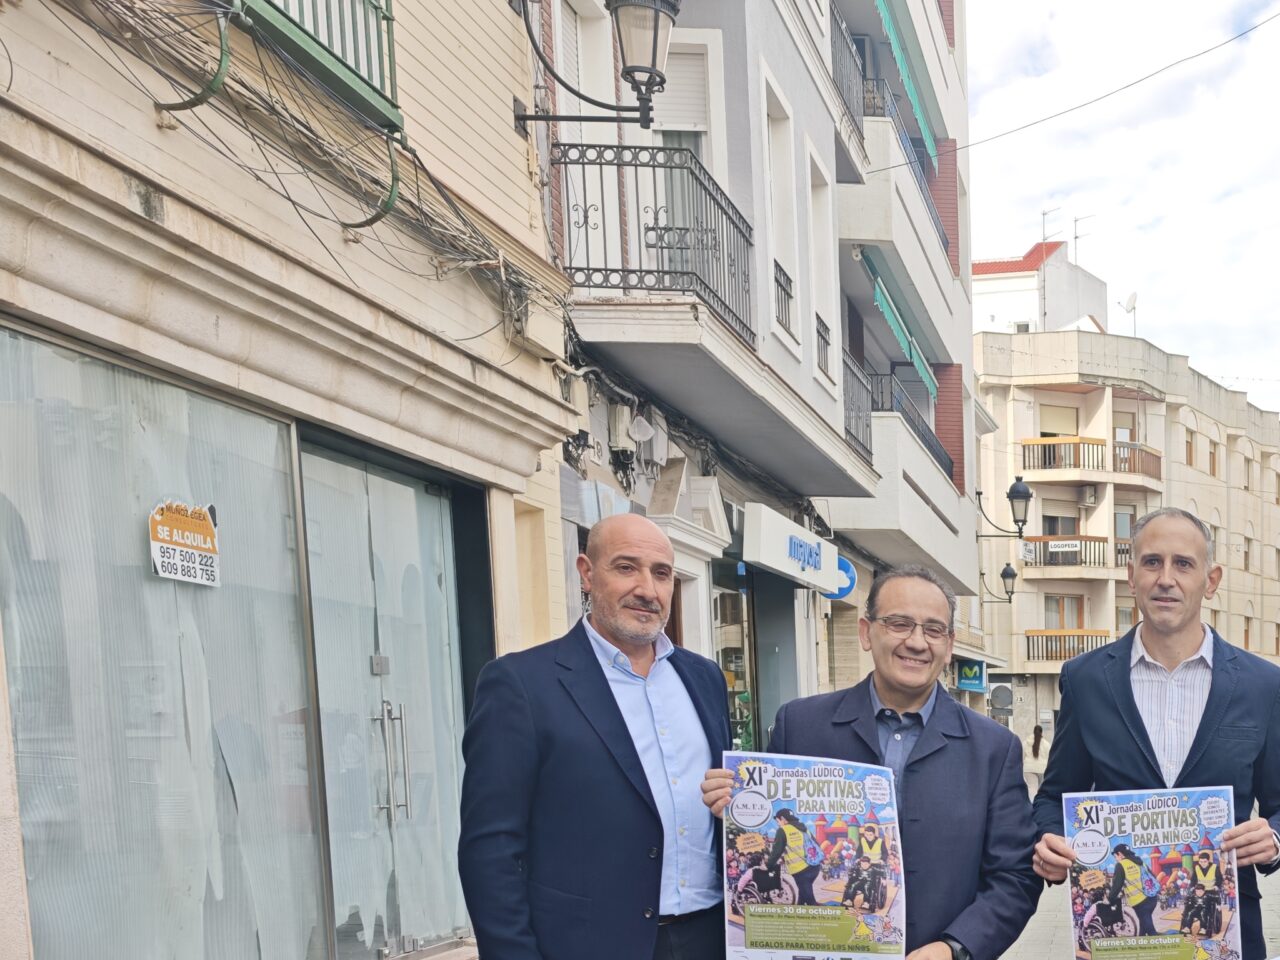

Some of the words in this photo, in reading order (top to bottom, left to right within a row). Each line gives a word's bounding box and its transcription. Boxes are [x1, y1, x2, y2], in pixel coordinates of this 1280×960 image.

[157, 525, 170, 540] SE
[172, 528, 212, 549] ALQUILA
[160, 546, 176, 560] 957
[180, 550, 196, 564] 500
[199, 554, 214, 568] 222
[161, 561, 178, 576] 609
[181, 564, 197, 580] 883
[200, 568, 216, 582] 755
[772, 768, 808, 778] Jornadas
[812, 764, 844, 777] LÚDICO
[798, 800, 825, 812] PARA
[828, 798, 865, 814] NIÑ@S
[1108, 803, 1142, 816] Jornadas
[1146, 795, 1178, 810] LÚDICO
[1134, 833, 1160, 846] PARA
[1162, 829, 1199, 844] NIÑ@S
[750, 941, 784, 949] REGALOS
[1095, 938, 1124, 946] Viernes
